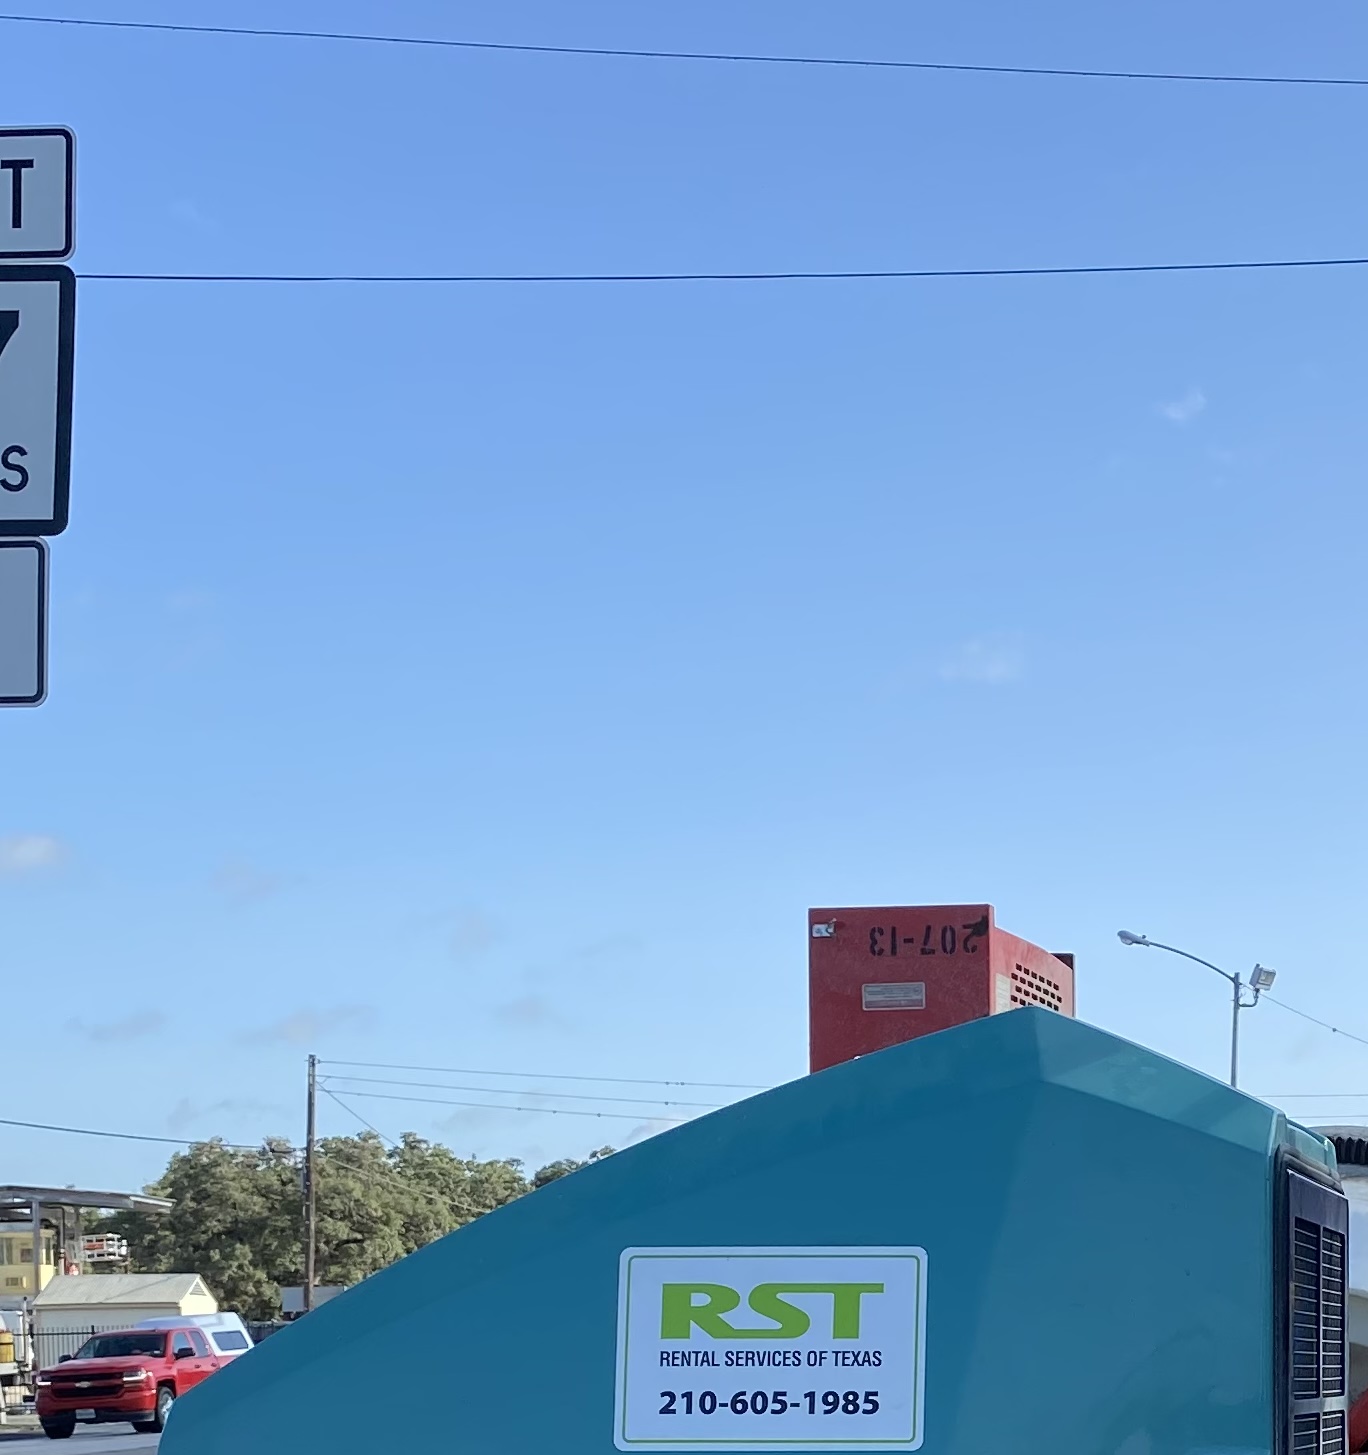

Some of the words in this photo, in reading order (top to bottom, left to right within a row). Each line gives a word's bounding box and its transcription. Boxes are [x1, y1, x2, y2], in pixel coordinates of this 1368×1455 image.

[870, 924, 983, 956] 207-13
[660, 1282, 885, 1340] RST
[659, 1350, 720, 1368] RENTAL
[724, 1350, 802, 1368] SERVICES
[806, 1350, 829, 1368] OF
[832, 1350, 883, 1368] TEXAS
[658, 1390, 881, 1416] 210-605-1985
